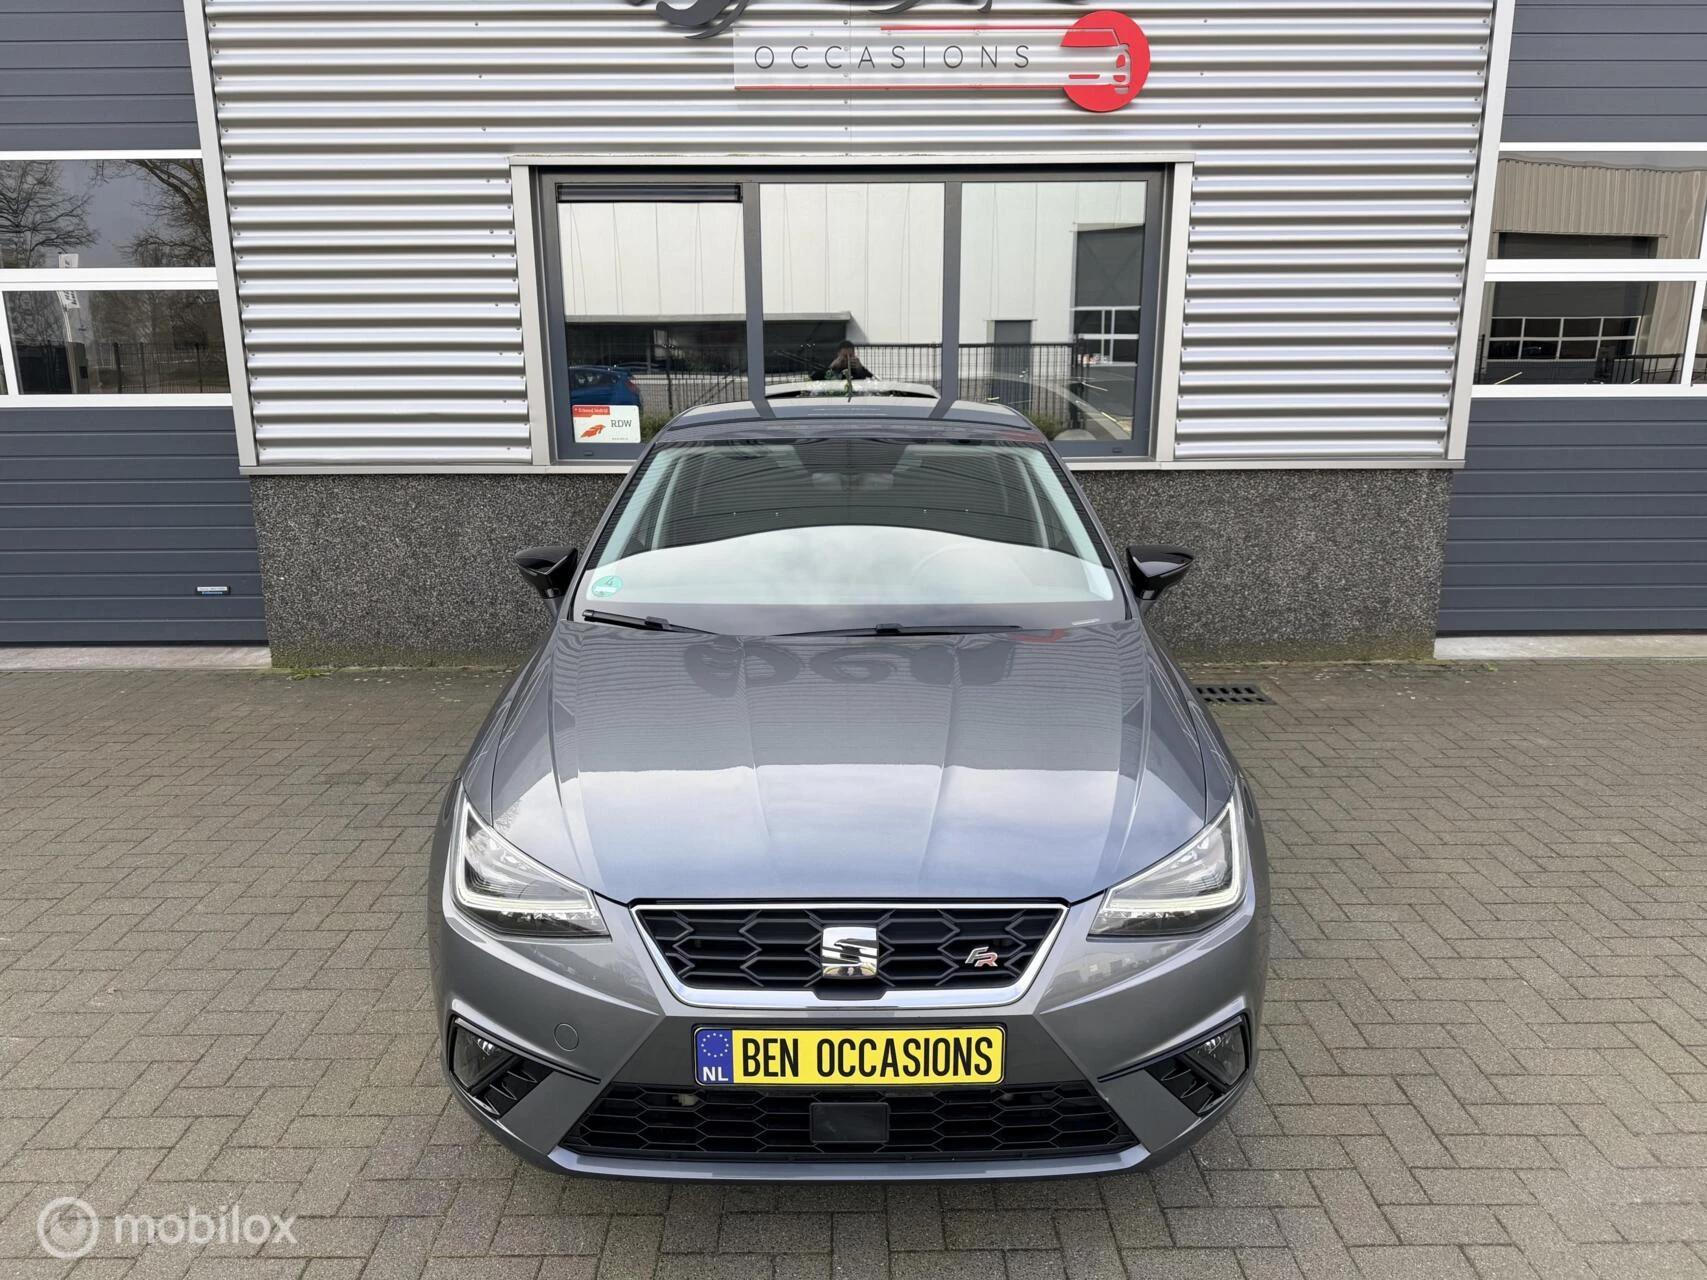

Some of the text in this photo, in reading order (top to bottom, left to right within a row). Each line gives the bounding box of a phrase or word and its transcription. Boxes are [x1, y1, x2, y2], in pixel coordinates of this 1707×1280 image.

[754, 45, 1030, 69] OCCASIONS
[610, 419, 632, 428] RDW
[965, 946, 998, 967] FR
[742, 1037, 993, 1077] BEN OCCASIONS
[703, 1066, 729, 1082] NL
